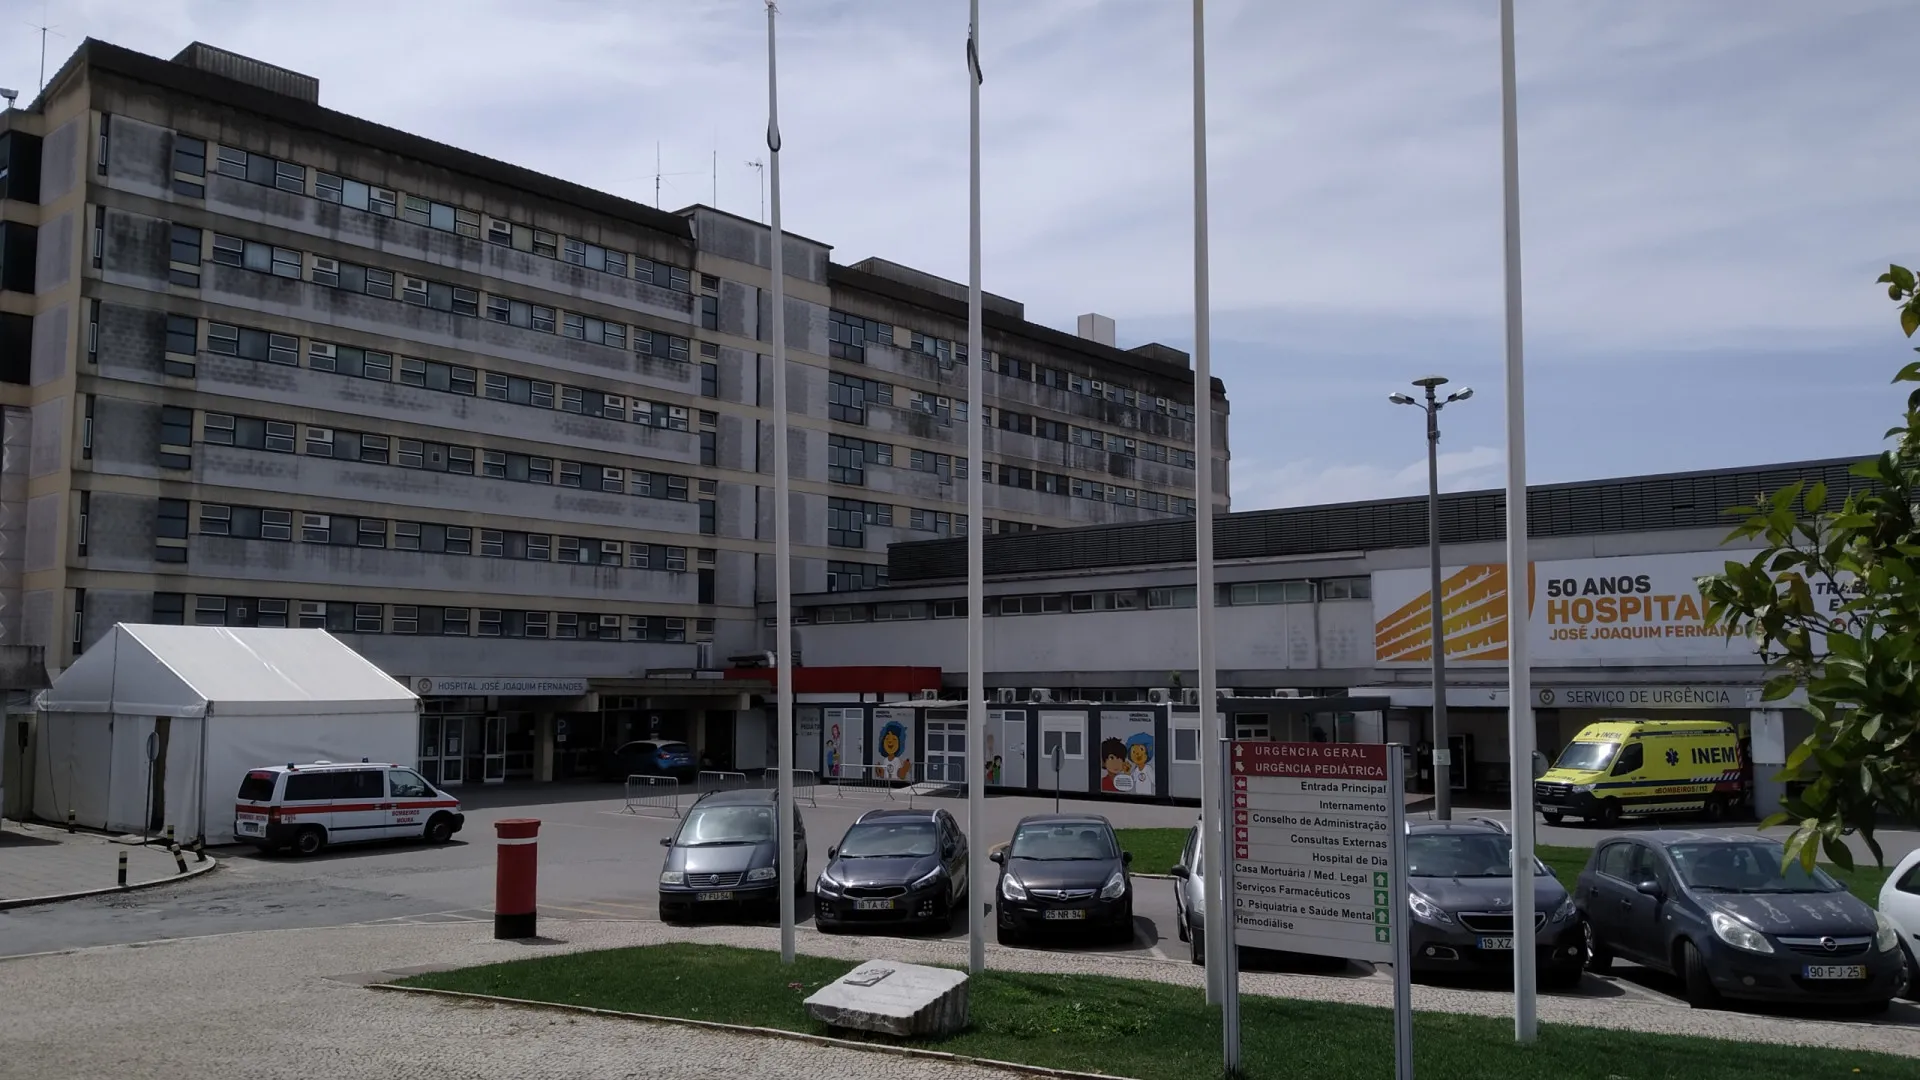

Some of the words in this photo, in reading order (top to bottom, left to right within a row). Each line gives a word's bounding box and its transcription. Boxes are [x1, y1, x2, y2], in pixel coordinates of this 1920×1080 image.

[1547, 578, 1577, 598] 50
[1582, 575, 1652, 596] ANOS
[1549, 625, 1588, 641] JOSÉ
[1590, 625, 1661, 641] JOAQUIM
[438, 681, 477, 691] HOSPITAL
[480, 681, 499, 691] JOSÉ
[502, 682, 536, 691] JOAQUIM
[538, 682, 583, 691] FERNANDES
[1566, 690, 1625, 706] SERVIÇO
[1629, 690, 1649, 703] DE
[1653, 686, 1730, 703] URGÊNCIA
[557, 719, 566, 733] P
[651, 715, 659, 728] P
[1255, 745, 1319, 757] URGÊNCIA
[1323, 747, 1367, 758] GERAL
[1691, 746, 1735, 765] INEM
[1255, 761, 1312, 774] URGÊNCIA
[1315, 763, 1384, 776] PEDIÁTRICA
[1301, 781, 1339, 792] Entrada
[1342, 783, 1386, 795] Principal
[1319, 800, 1386, 812] Internamento
[1253, 814, 1297, 825] Conselho
[1300, 816, 1312, 826] de
[1314, 817, 1387, 831] Administração
[1290, 834, 1340, 846] Consultas
[1342, 837, 1387, 849] Externas
[1312, 852, 1353, 865] Hospital
[1356, 855, 1369, 865] de
[1371, 856, 1388, 866] Dia
[1235, 864, 1258, 874] Casa
[1260, 865, 1306, 878] Mortuária
[1307, 869, 1312, 879] /
[1314, 870, 1338, 881] Med.
[1340, 872, 1368, 884] Legal
[1236, 881, 1277, 894] Serviços
[1236, 898, 1247, 909] D.
[1248, 900, 1298, 913] Psiquiatria
[1300, 906, 1306, 914] e
[1309, 905, 1339, 917] Saúde
[1341, 909, 1375, 921] Mental
[1236, 915, 1294, 930] Hemodiálise
